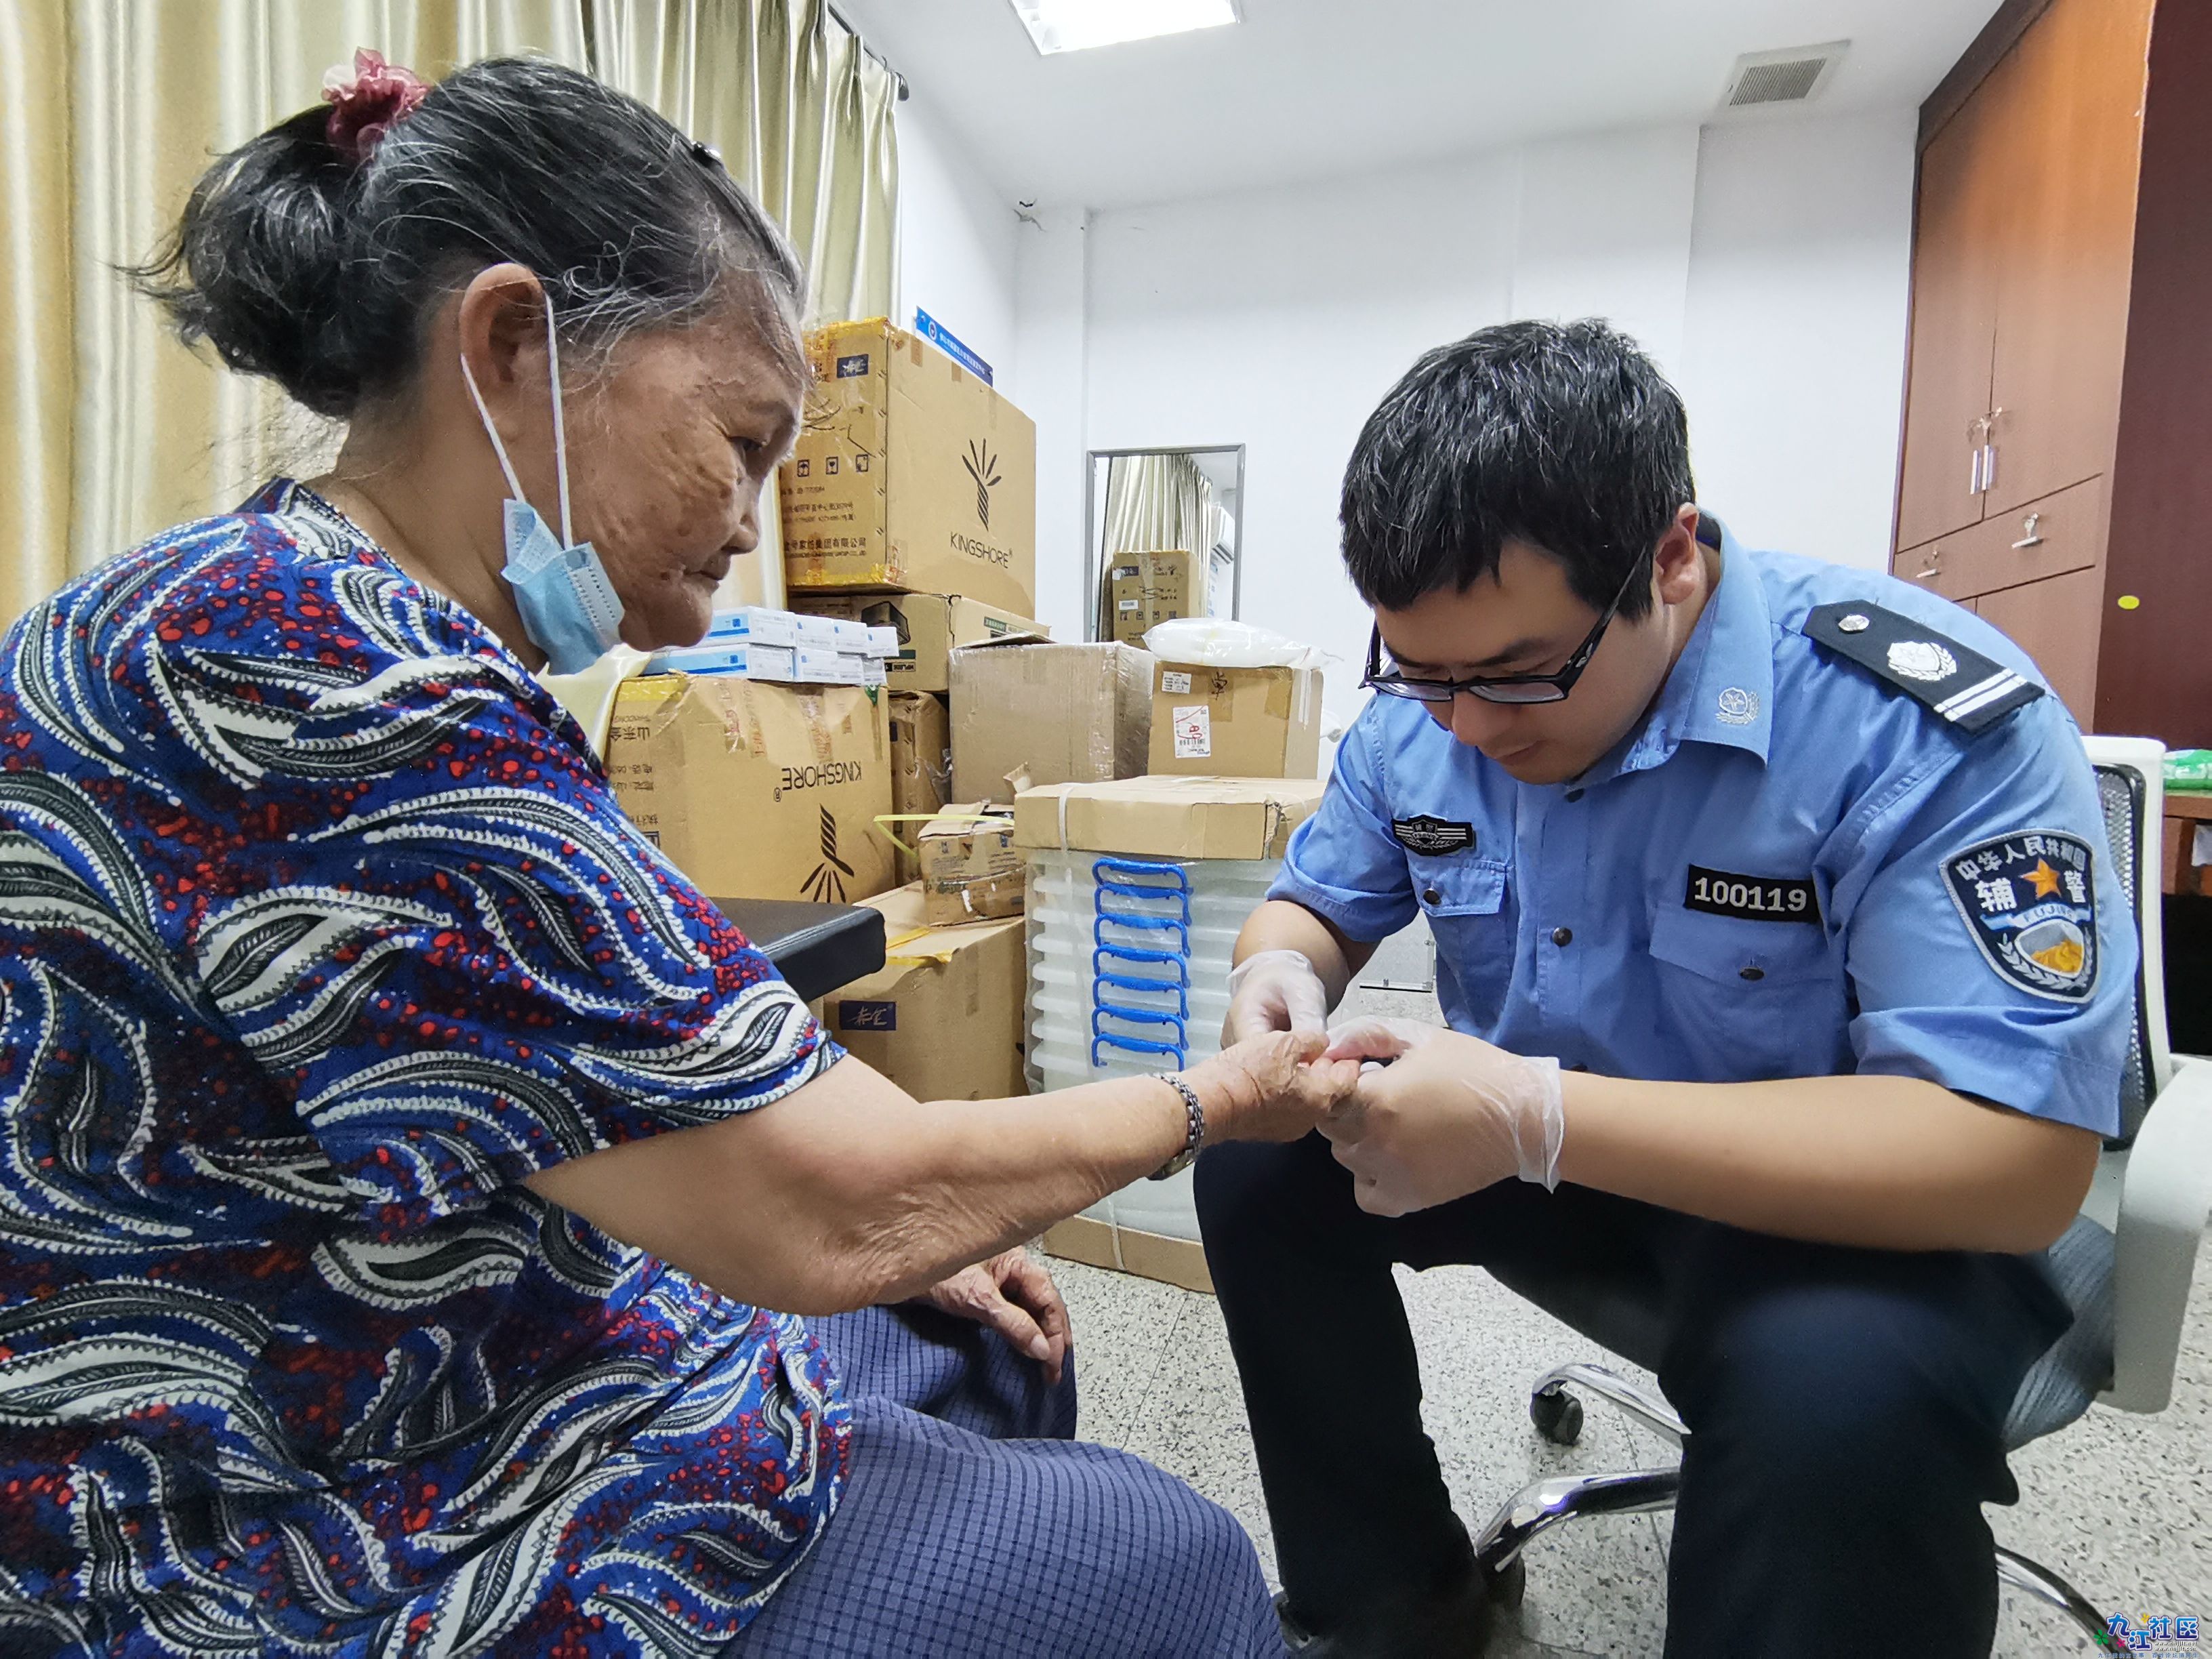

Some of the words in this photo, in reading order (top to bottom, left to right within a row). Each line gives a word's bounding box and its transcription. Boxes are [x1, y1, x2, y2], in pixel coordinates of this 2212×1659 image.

[950, 531, 1008, 569] KINGSHORE
[781, 760, 863, 791] KINGSHORE
[1955, 836, 2087, 881] 中华人民共和国
[1694, 876, 1807, 912] 100119
